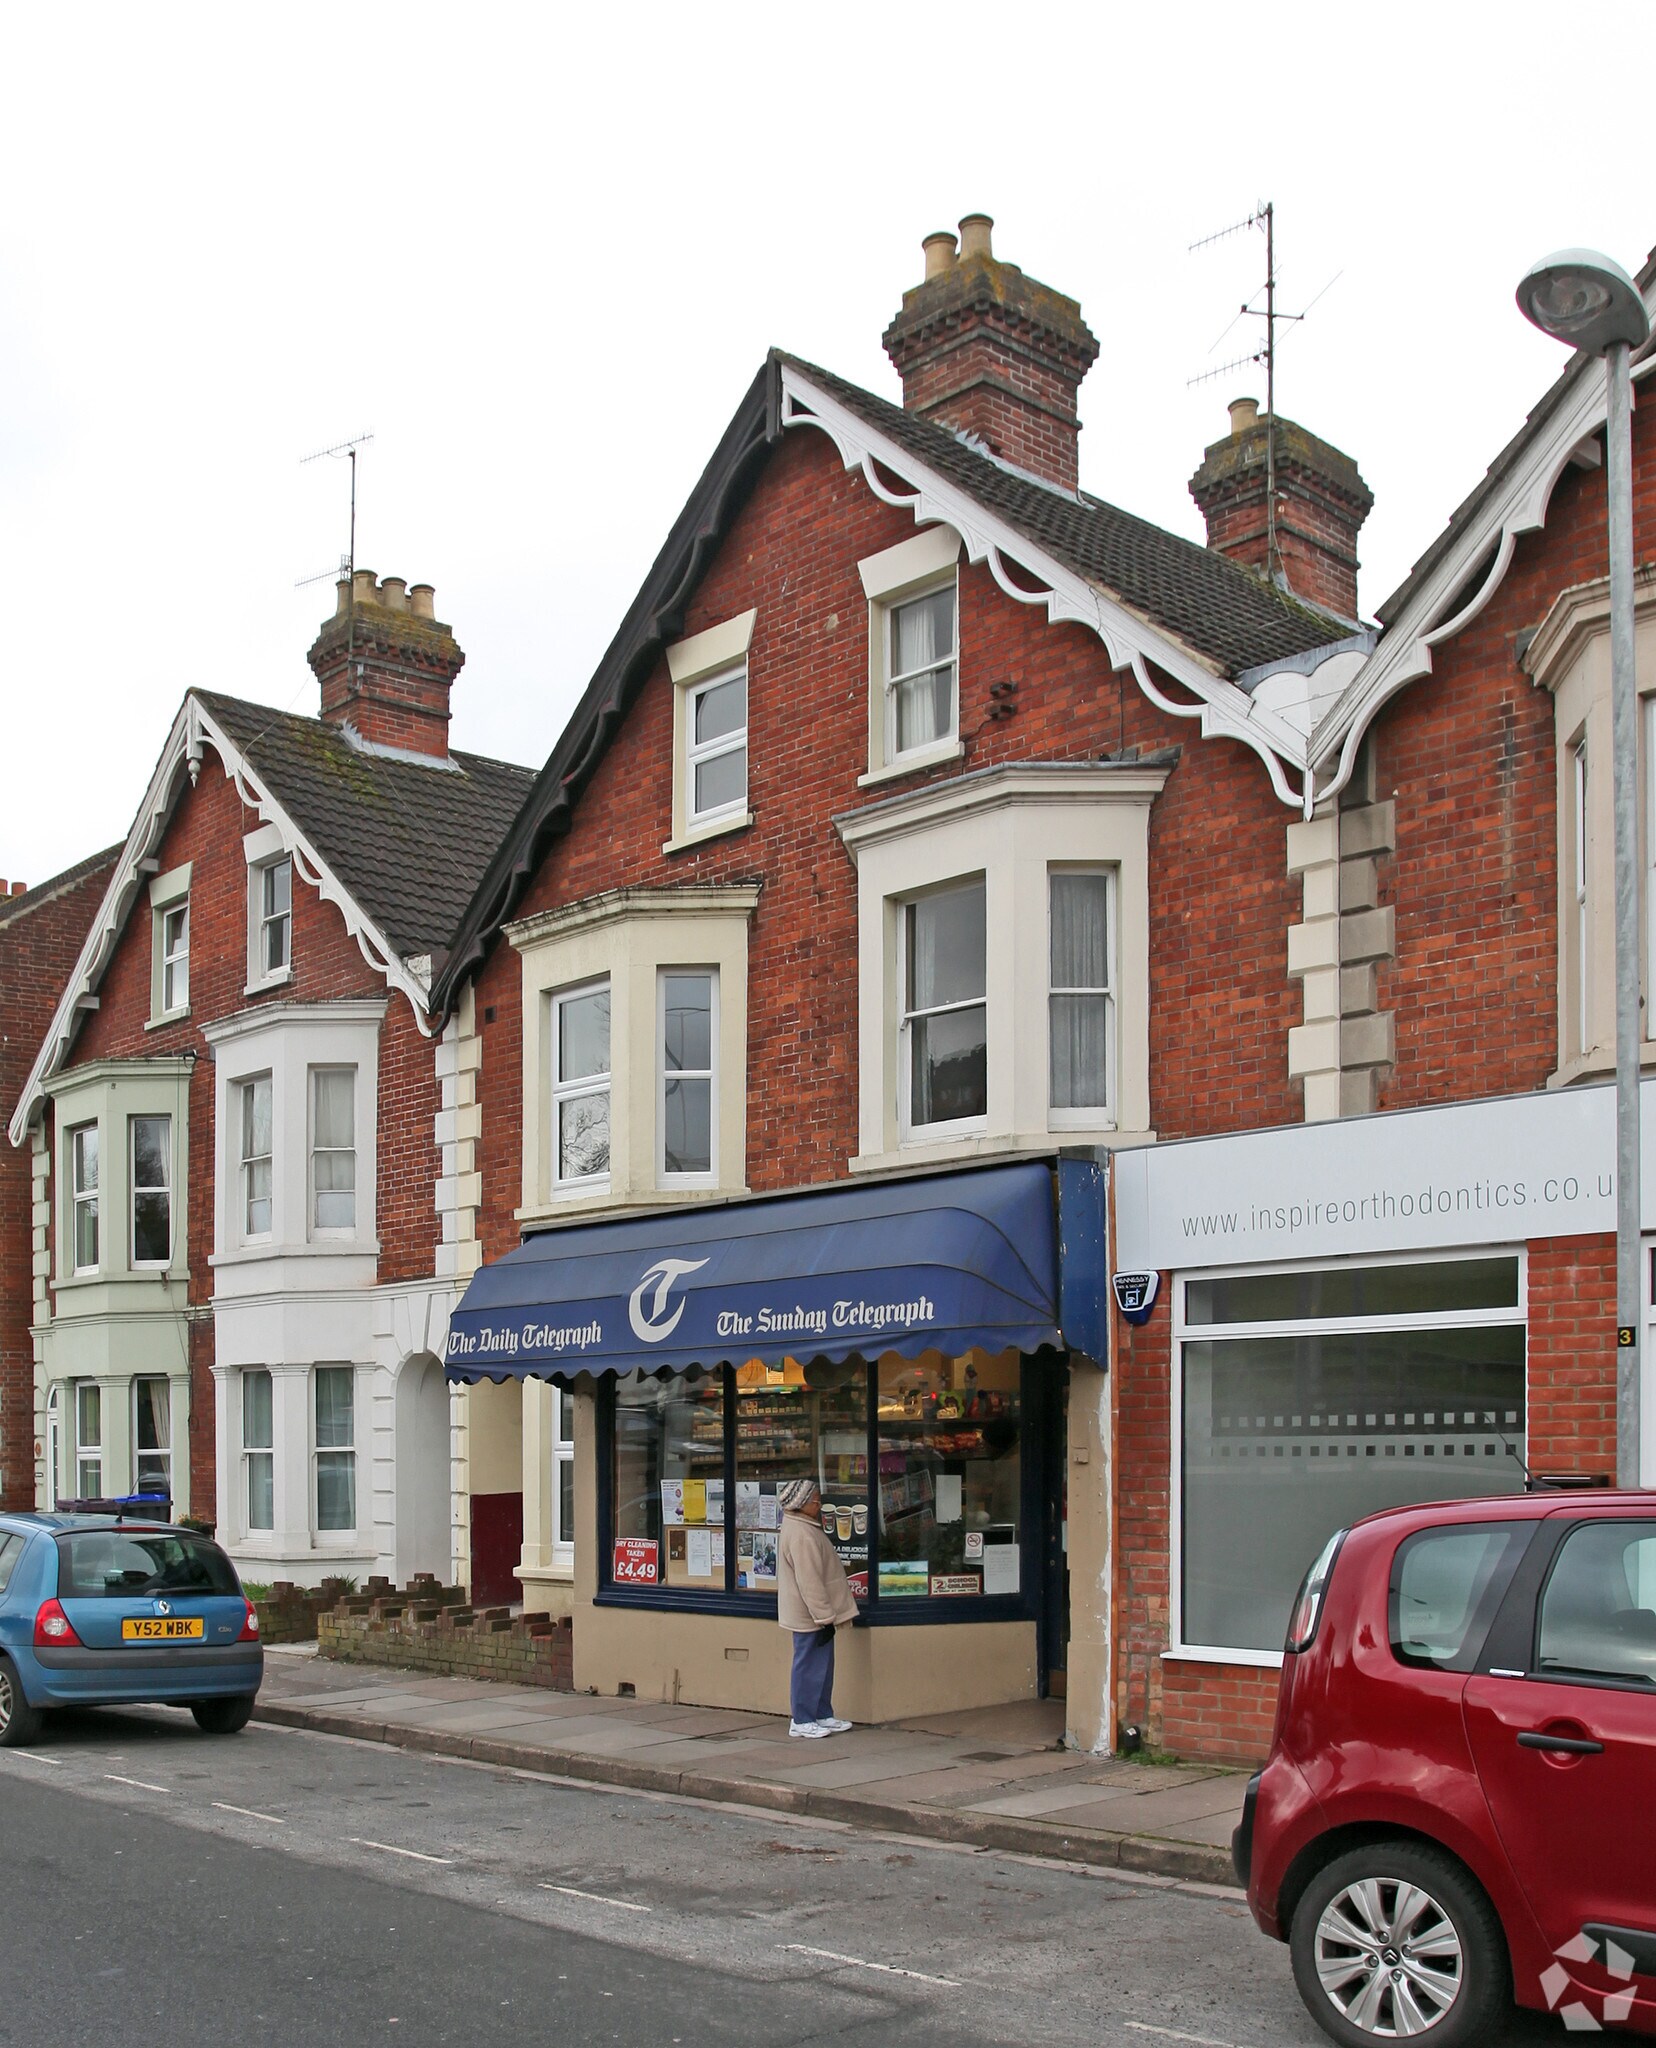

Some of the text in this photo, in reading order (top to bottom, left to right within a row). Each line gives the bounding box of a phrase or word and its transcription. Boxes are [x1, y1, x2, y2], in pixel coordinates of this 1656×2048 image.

[1182, 1174, 1613, 1237] www.inspireorthodontics.co.u
[716, 1295, 935, 1337] The Sunday Telegraph
[448, 1320, 602, 1355] The Daily Telegraph
[1619, 1329, 1631, 1344] 3
[628, 1541, 656, 1549] CLEANING
[617, 1561, 656, 1578] £4.49
[936, 1580, 944, 1589] 2
[133, 1621, 193, 1636] Y52 WBK
